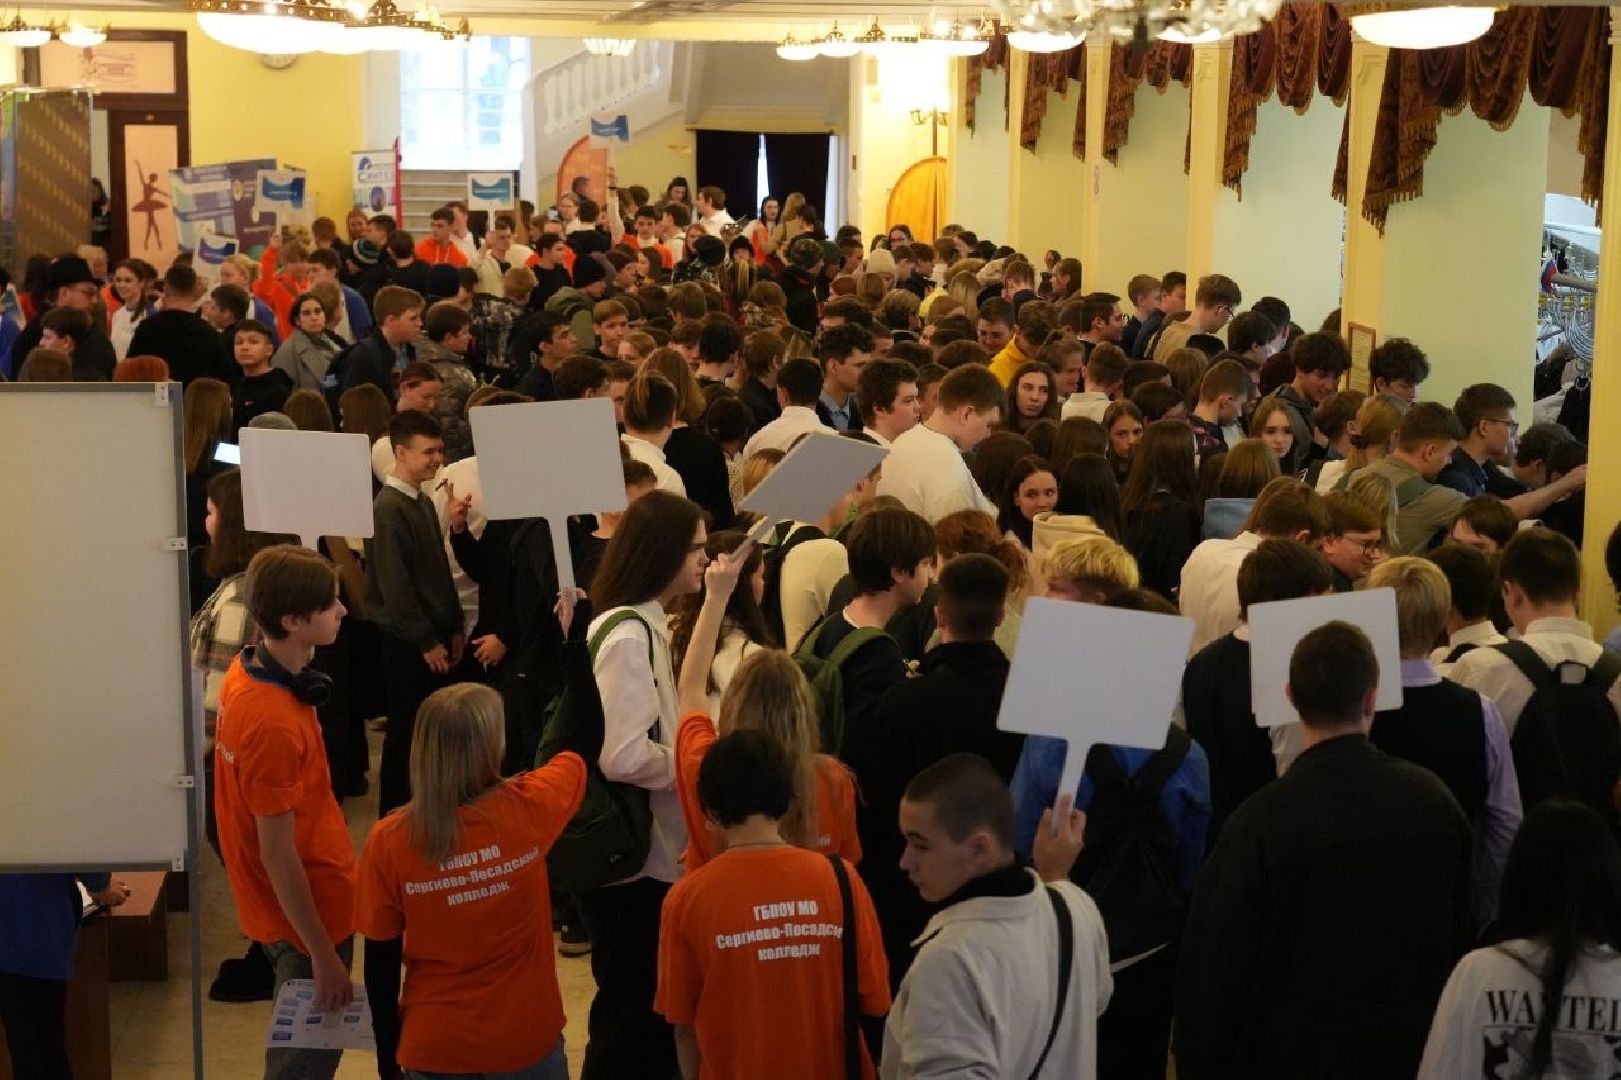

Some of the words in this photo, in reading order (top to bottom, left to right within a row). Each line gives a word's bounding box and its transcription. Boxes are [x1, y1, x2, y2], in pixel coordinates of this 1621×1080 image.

[479, 844, 501, 863] МО
[447, 881, 511, 907] колледж
[753, 901, 795, 921] ГБПОУ
[798, 900, 818, 916] МО
[716, 923, 843, 949] Сергиево-Посадск
[758, 943, 821, 961] колледж
[1484, 990, 1621, 1032] WATE
